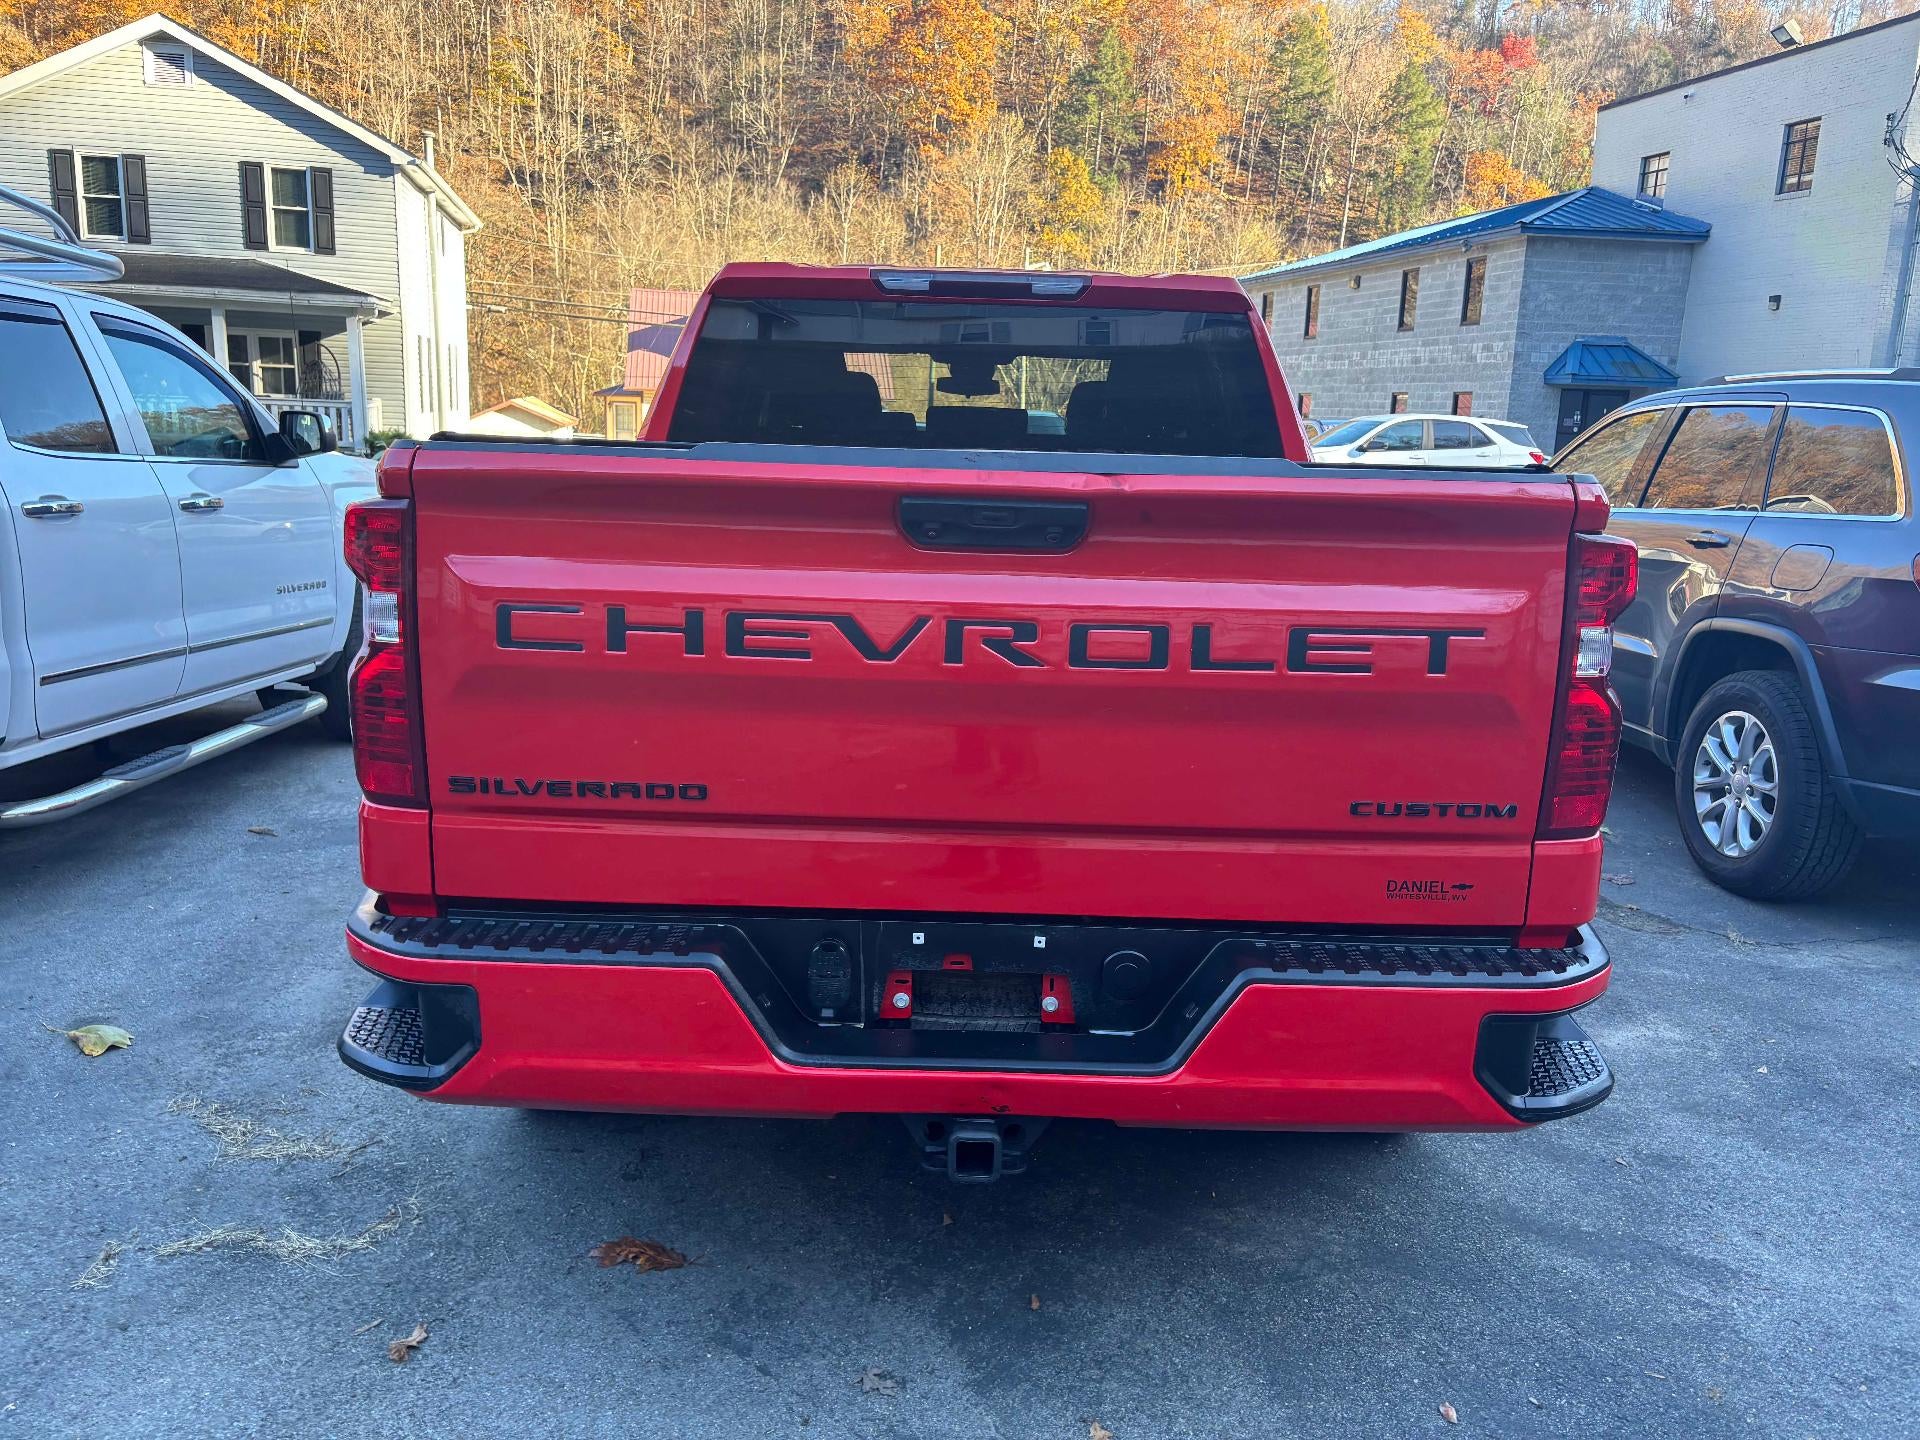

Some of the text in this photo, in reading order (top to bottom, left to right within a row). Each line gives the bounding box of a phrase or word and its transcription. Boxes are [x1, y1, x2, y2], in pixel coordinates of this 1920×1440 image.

[276, 580, 327, 595] SILVERADO
[496, 603, 1486, 676] CHEVROLET
[448, 775, 708, 800] SILVERADO
[1350, 801, 1518, 818] CUSTOM
[1386, 879, 1450, 894] DANIEL
